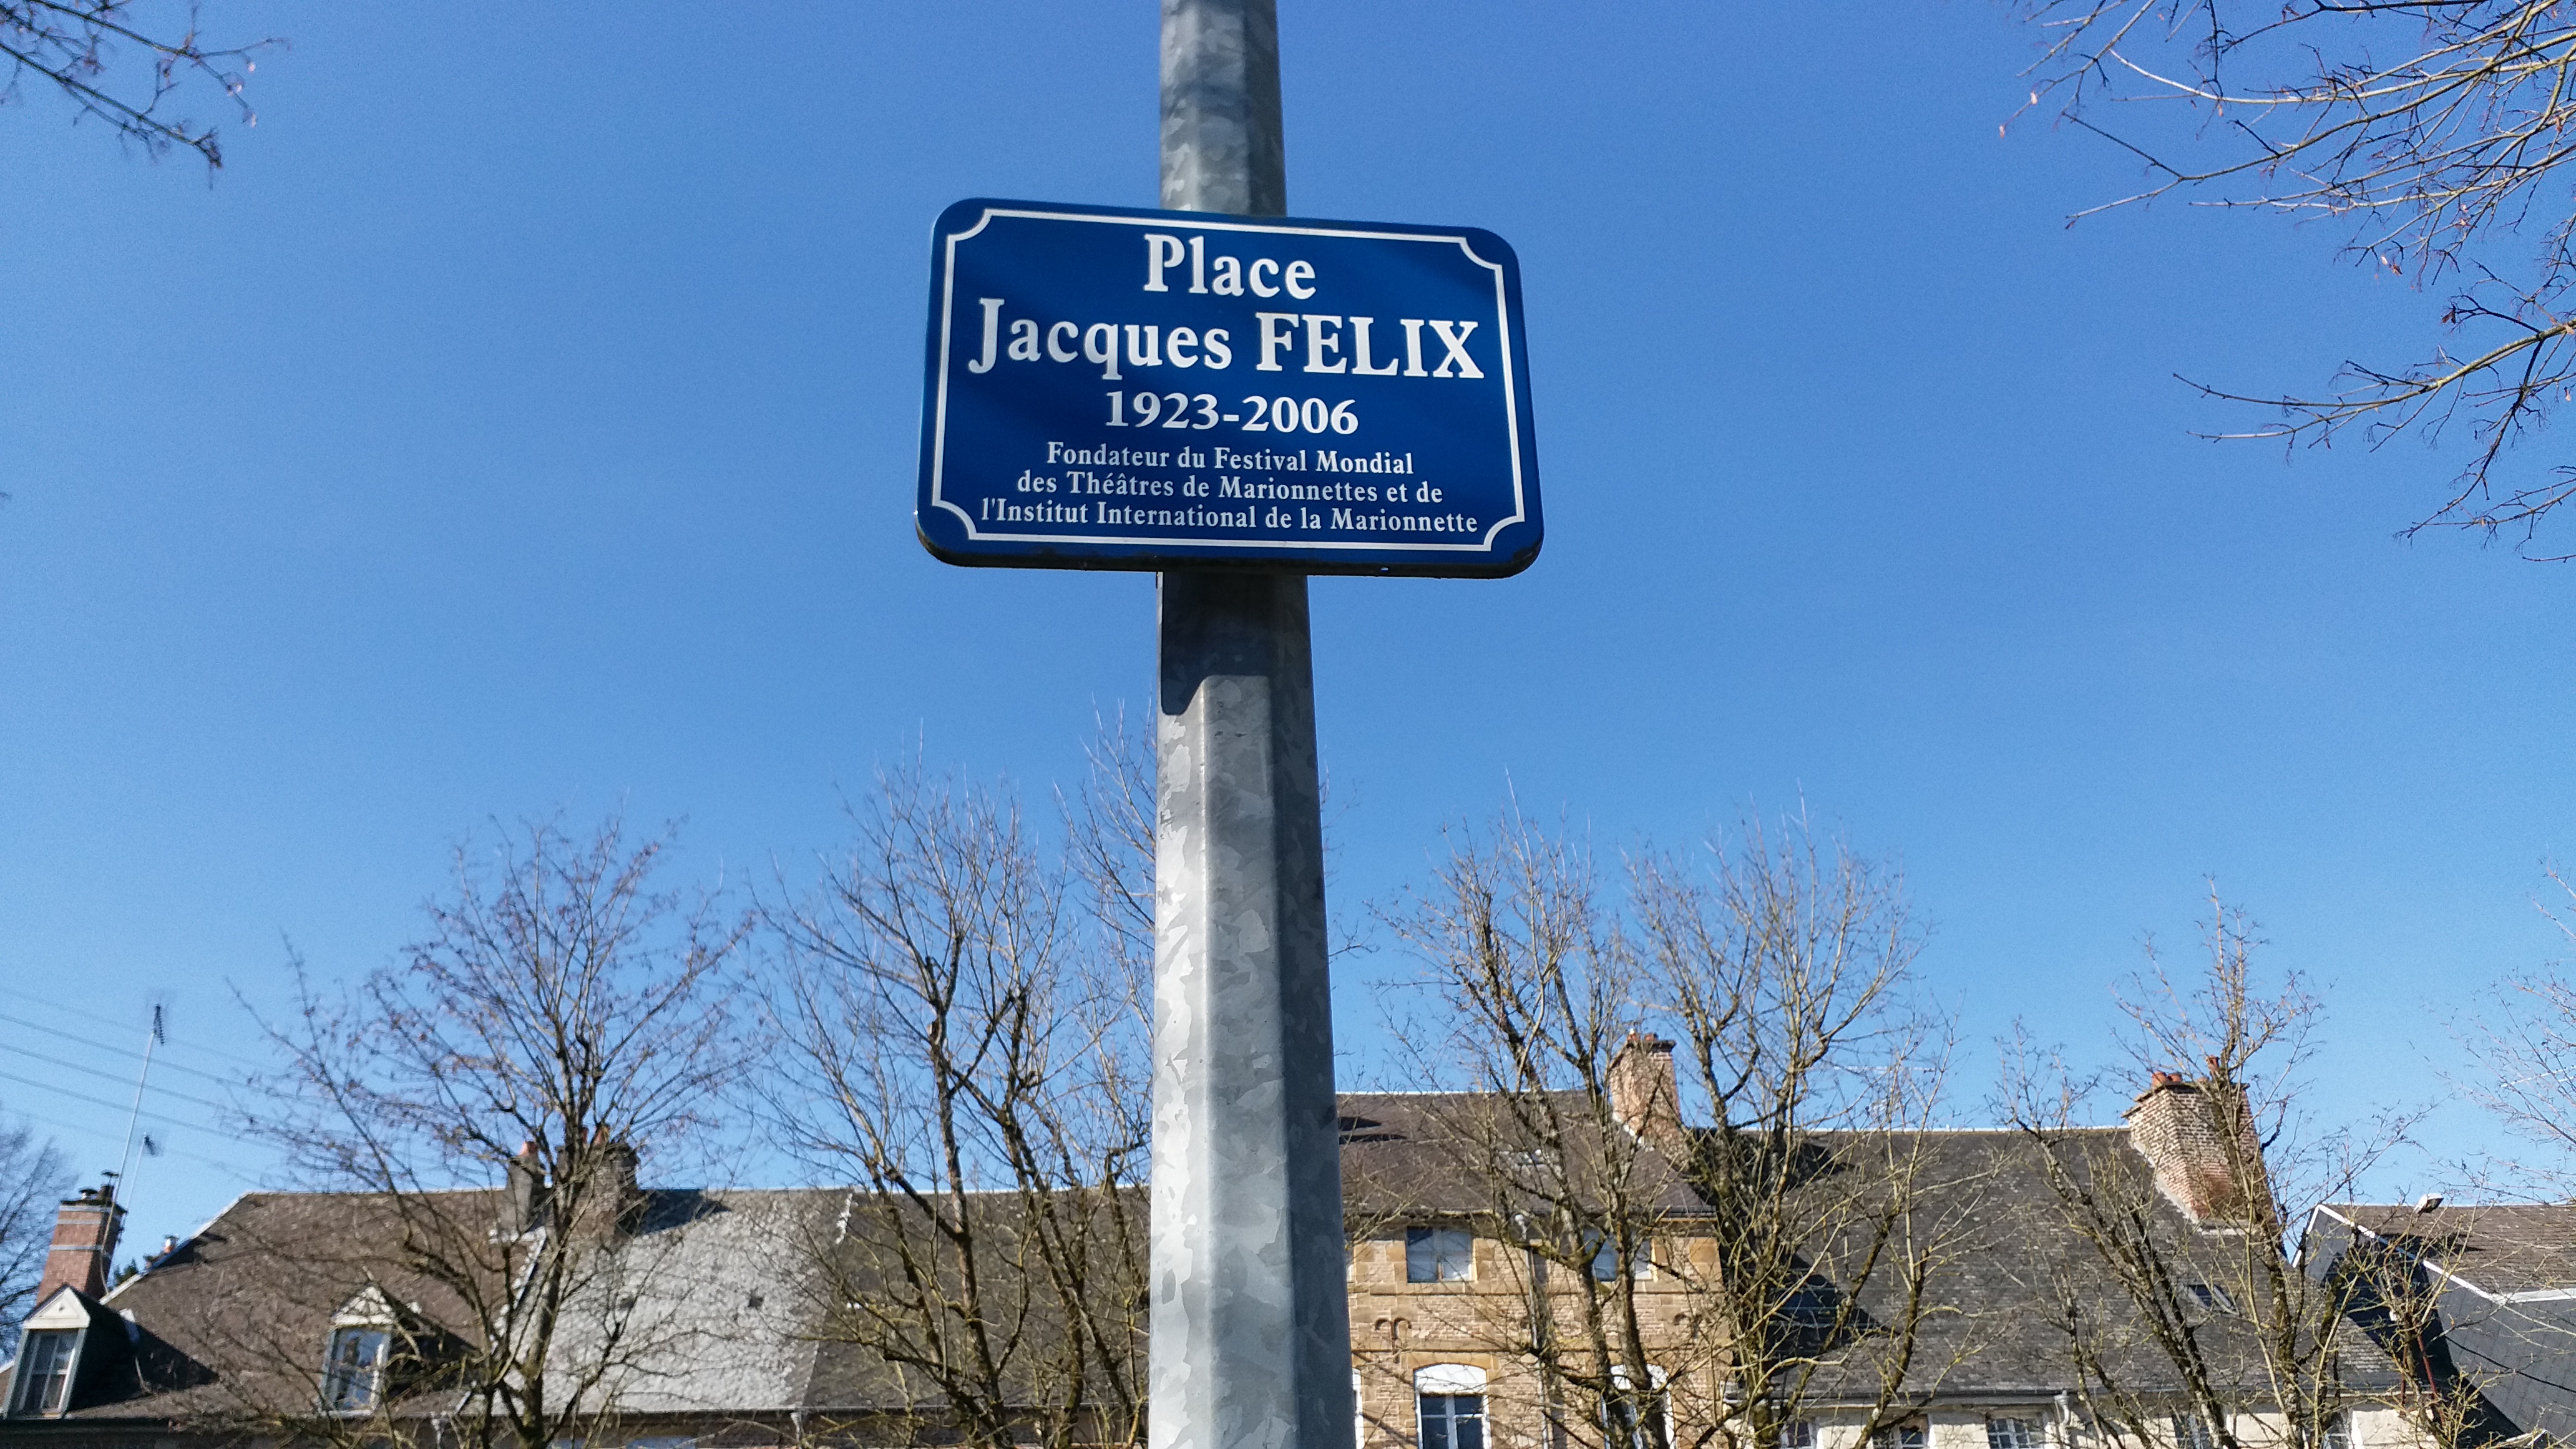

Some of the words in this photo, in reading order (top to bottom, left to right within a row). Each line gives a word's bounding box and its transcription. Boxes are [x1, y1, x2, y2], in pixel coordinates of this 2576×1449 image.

[1143, 233, 1316, 300] Place
[968, 298, 1232, 380] Jacques
[1256, 312, 1485, 379] FELIX
[1106, 391, 1359, 436] 1923-2006
[1047, 441, 1170, 467] Fondateur
[1178, 446, 1206, 469] du
[1214, 447, 1307, 471] Festival
[1315, 450, 1414, 474] Mondial
[1018, 469, 1057, 493] des
[1066, 471, 1174, 497] Théâtres
[1183, 475, 1209, 497] de
[1219, 476, 1378, 502] Marionnettes
[1387, 484, 1408, 503] et
[1416, 481, 1443, 504] de
[982, 497, 1088, 524] l'Institut
[1097, 501, 1257, 528] International
[1266, 506, 1292, 529] de
[1300, 507, 1322, 530] la
[1330, 507, 1478, 533] Marionnette
